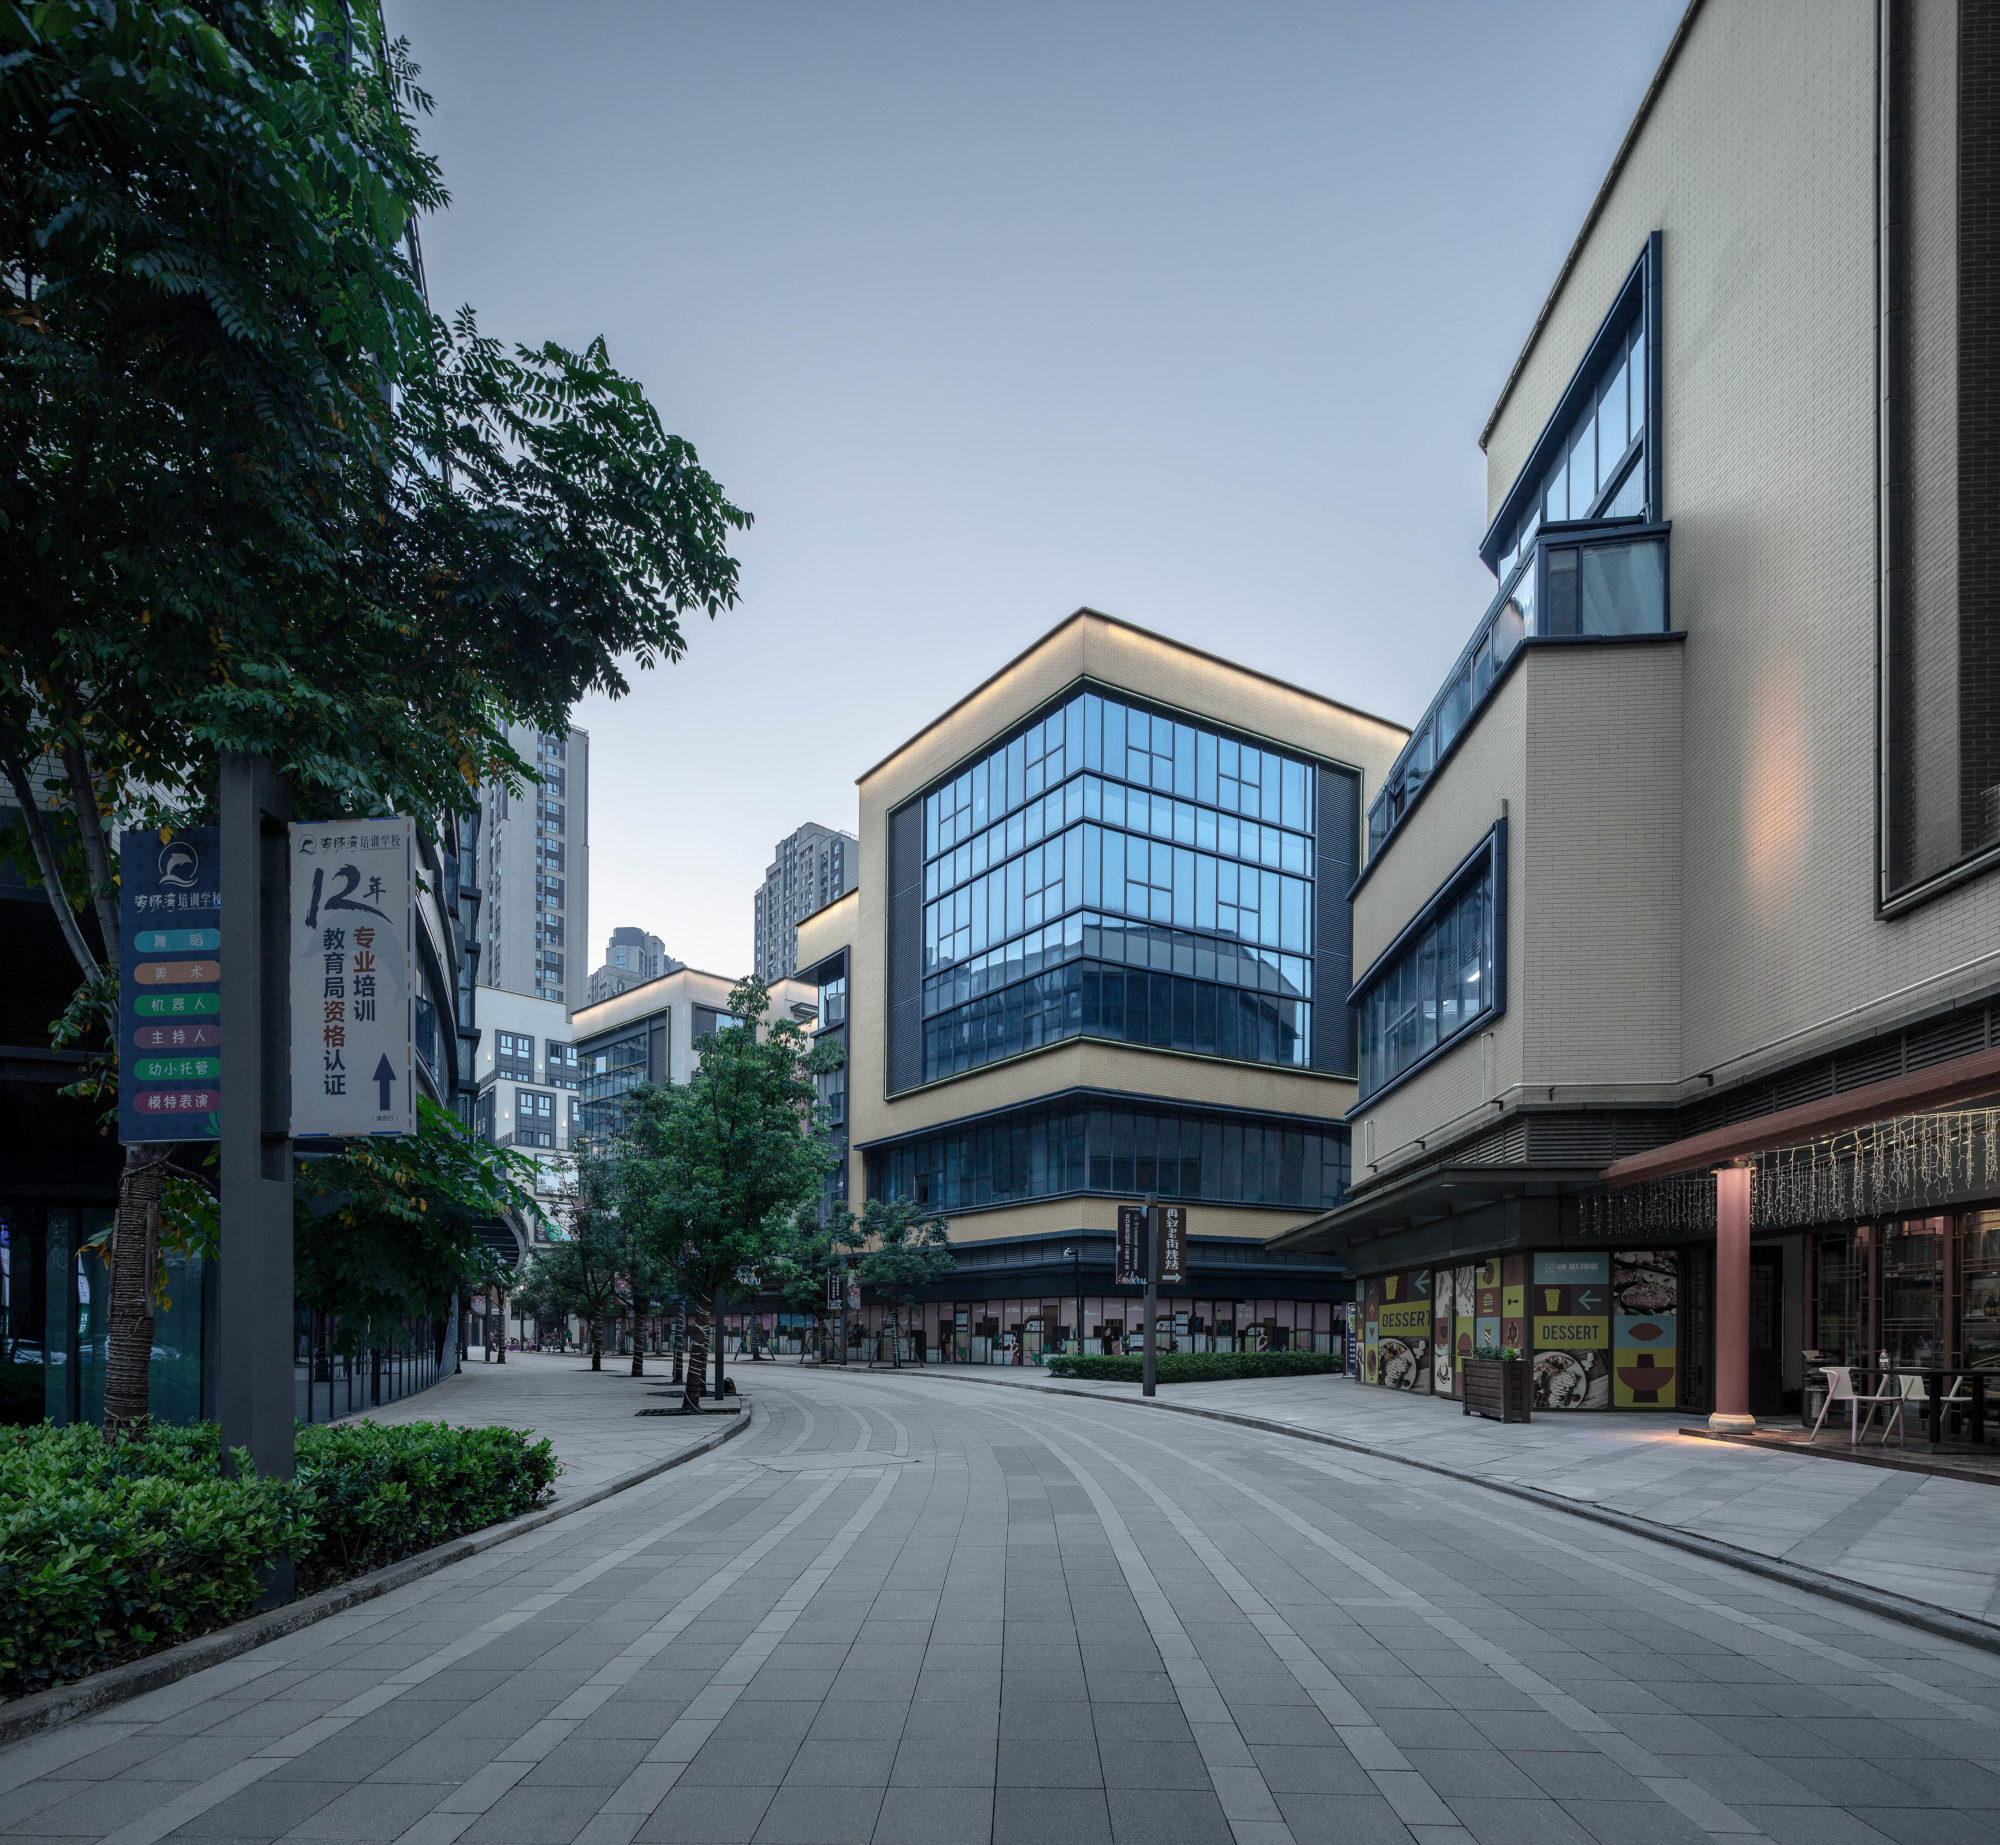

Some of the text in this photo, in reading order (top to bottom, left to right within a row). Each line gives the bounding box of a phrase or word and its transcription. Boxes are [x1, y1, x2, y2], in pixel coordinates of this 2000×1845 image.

[153, 932, 204, 947] 舞蹈
[154, 965, 204, 980] 美术
[353, 926, 376, 1022] 专业培训
[151, 996, 206, 1012] 机器人
[323, 928, 346, 1096] 教育局资格认证
[151, 1028, 206, 1044] 主持人
[148, 1060, 209, 1076] 幼小托管
[148, 1093, 209, 1110] 模特表演
[1382, 1310, 1430, 1327] DESSERT
[1542, 1325, 1599, 1340] DESSERT
